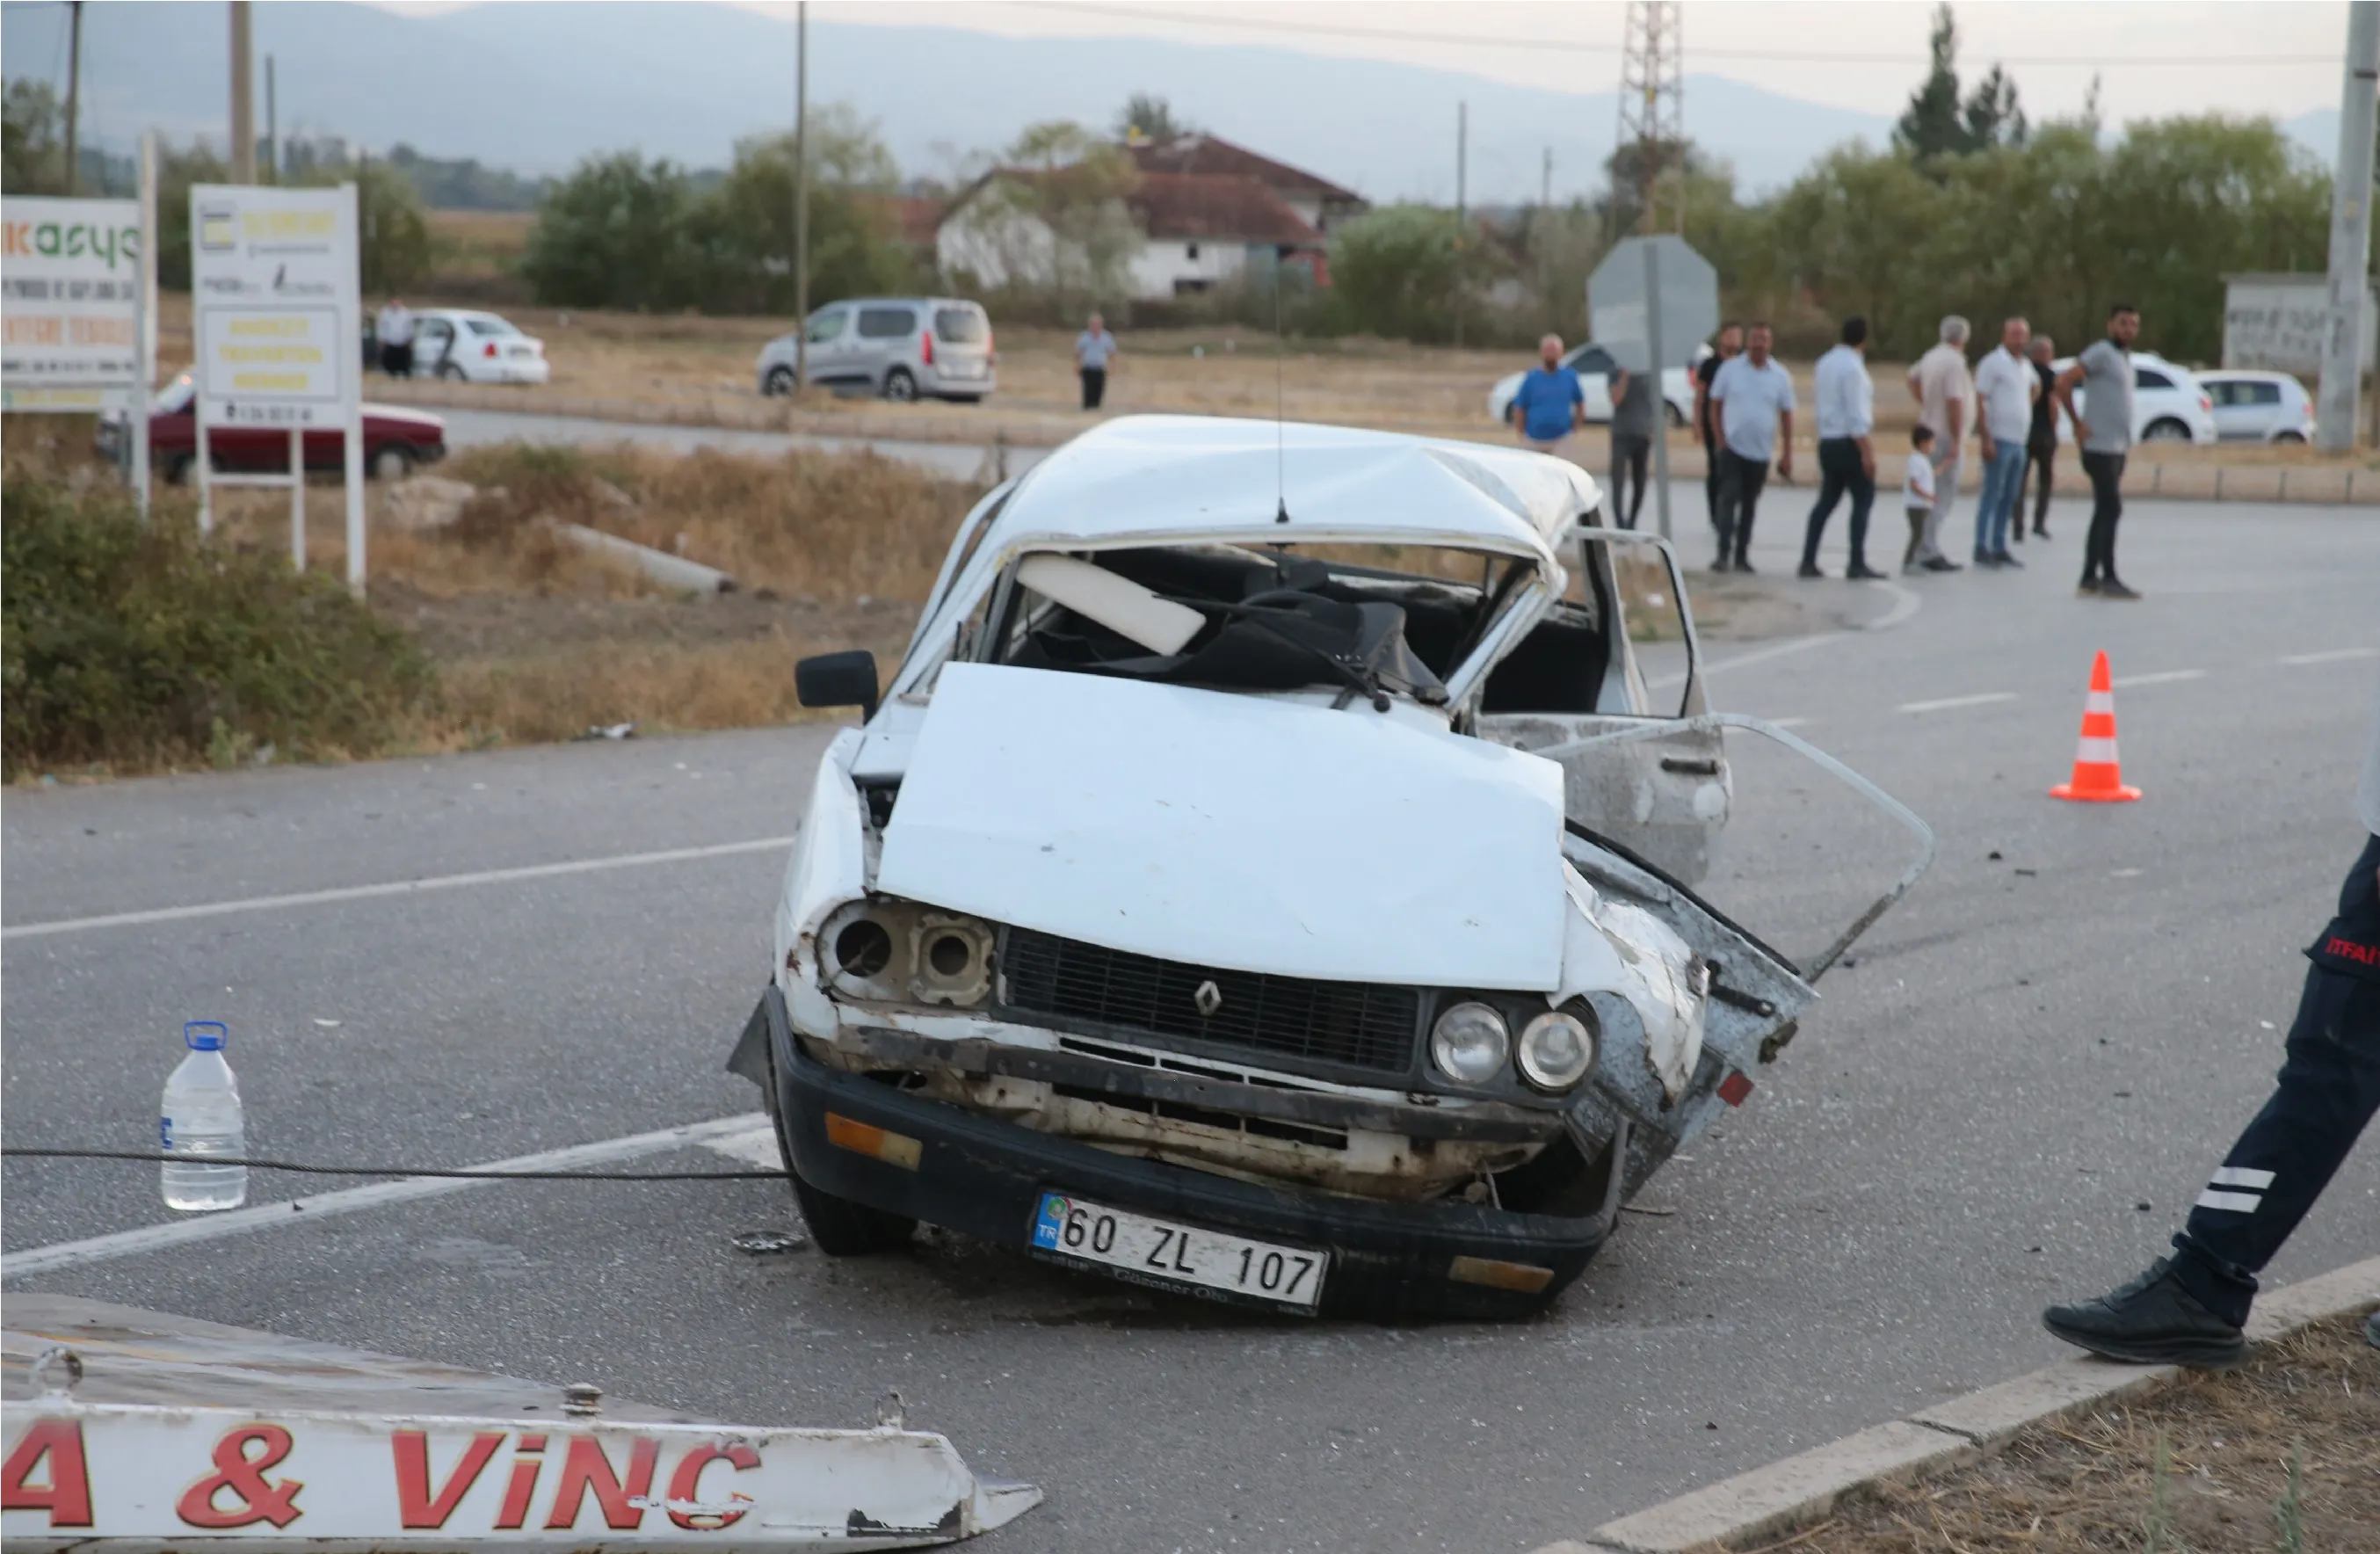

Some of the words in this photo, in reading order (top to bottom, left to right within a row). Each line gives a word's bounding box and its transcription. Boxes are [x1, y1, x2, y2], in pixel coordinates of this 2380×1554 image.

[1038, 1224, 1058, 1240] TR
[1064, 1208, 1116, 1253] 60
[1144, 1226, 1194, 1274] ZL
[1238, 1246, 1314, 1295] 107
[176, 1421, 305, 1530] &
